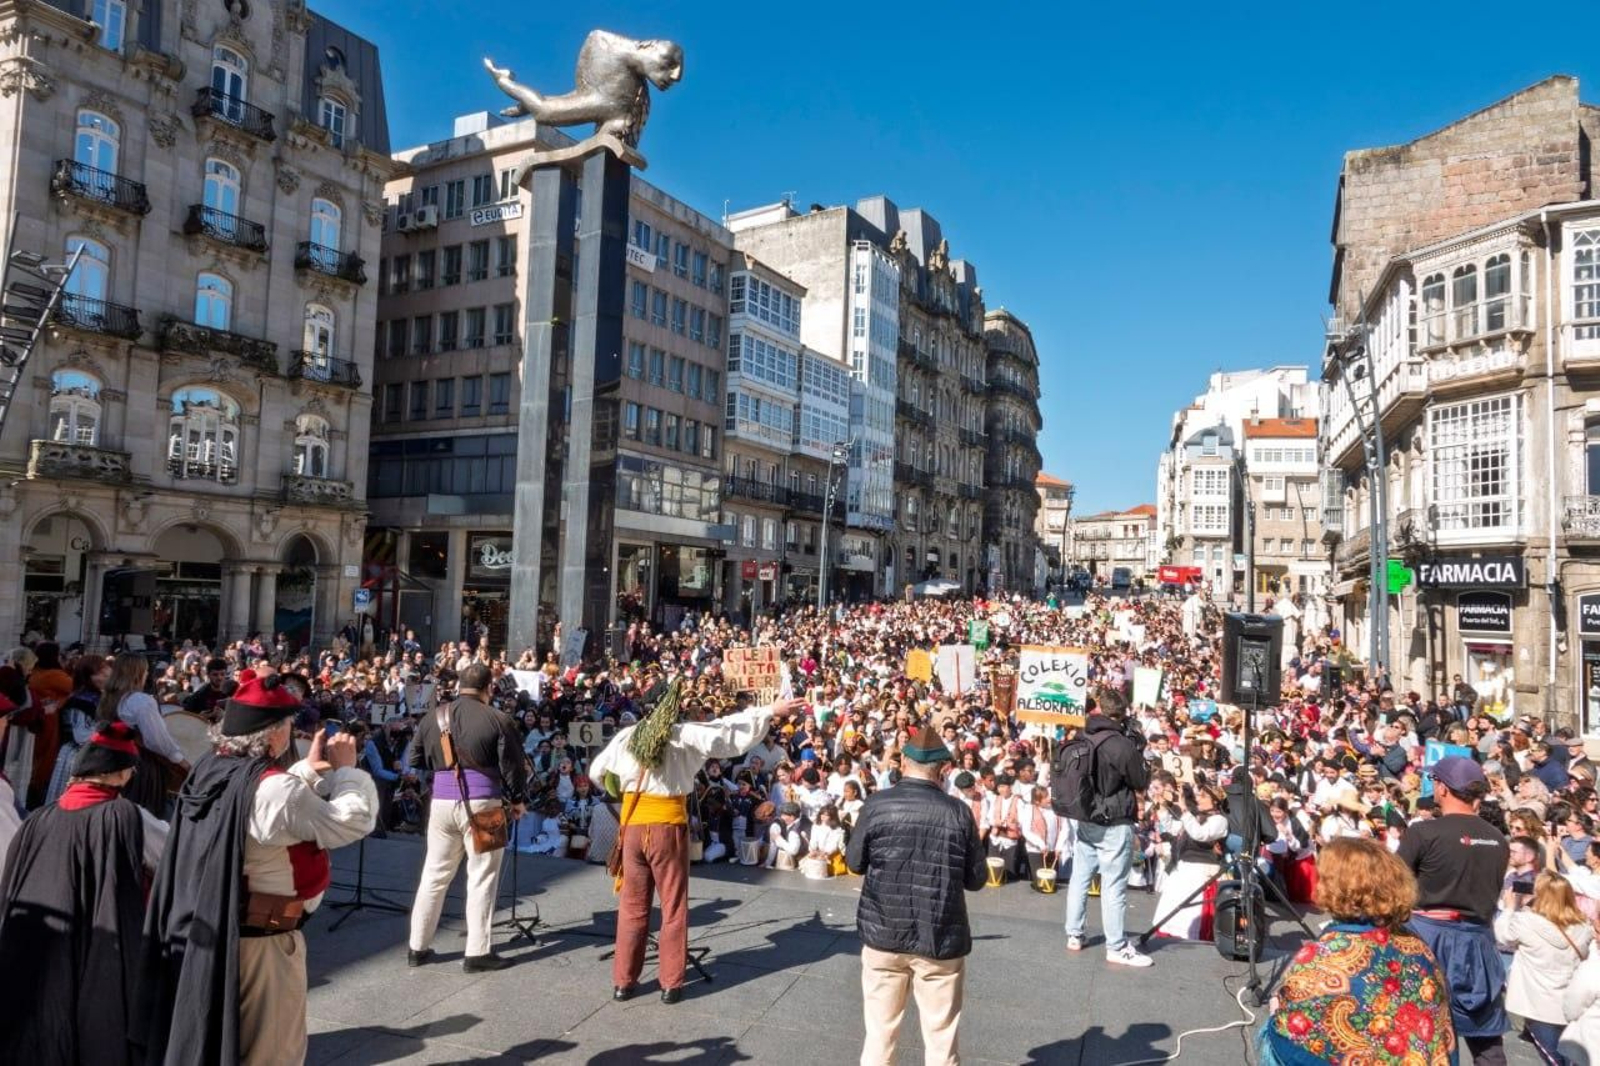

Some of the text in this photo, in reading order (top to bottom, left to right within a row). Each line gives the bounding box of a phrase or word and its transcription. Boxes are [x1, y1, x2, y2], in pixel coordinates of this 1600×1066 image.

[1420, 562, 1518, 583] FARMACIA
[1459, 604, 1509, 615] FARMACIA
[1583, 604, 1600, 615] FA
[1020, 659, 1086, 688] COLEXIO
[379, 705, 387, 722] 7
[1016, 697, 1085, 717] ALBORADA
[579, 723, 593, 744] 6
[1172, 757, 1184, 778] 3
